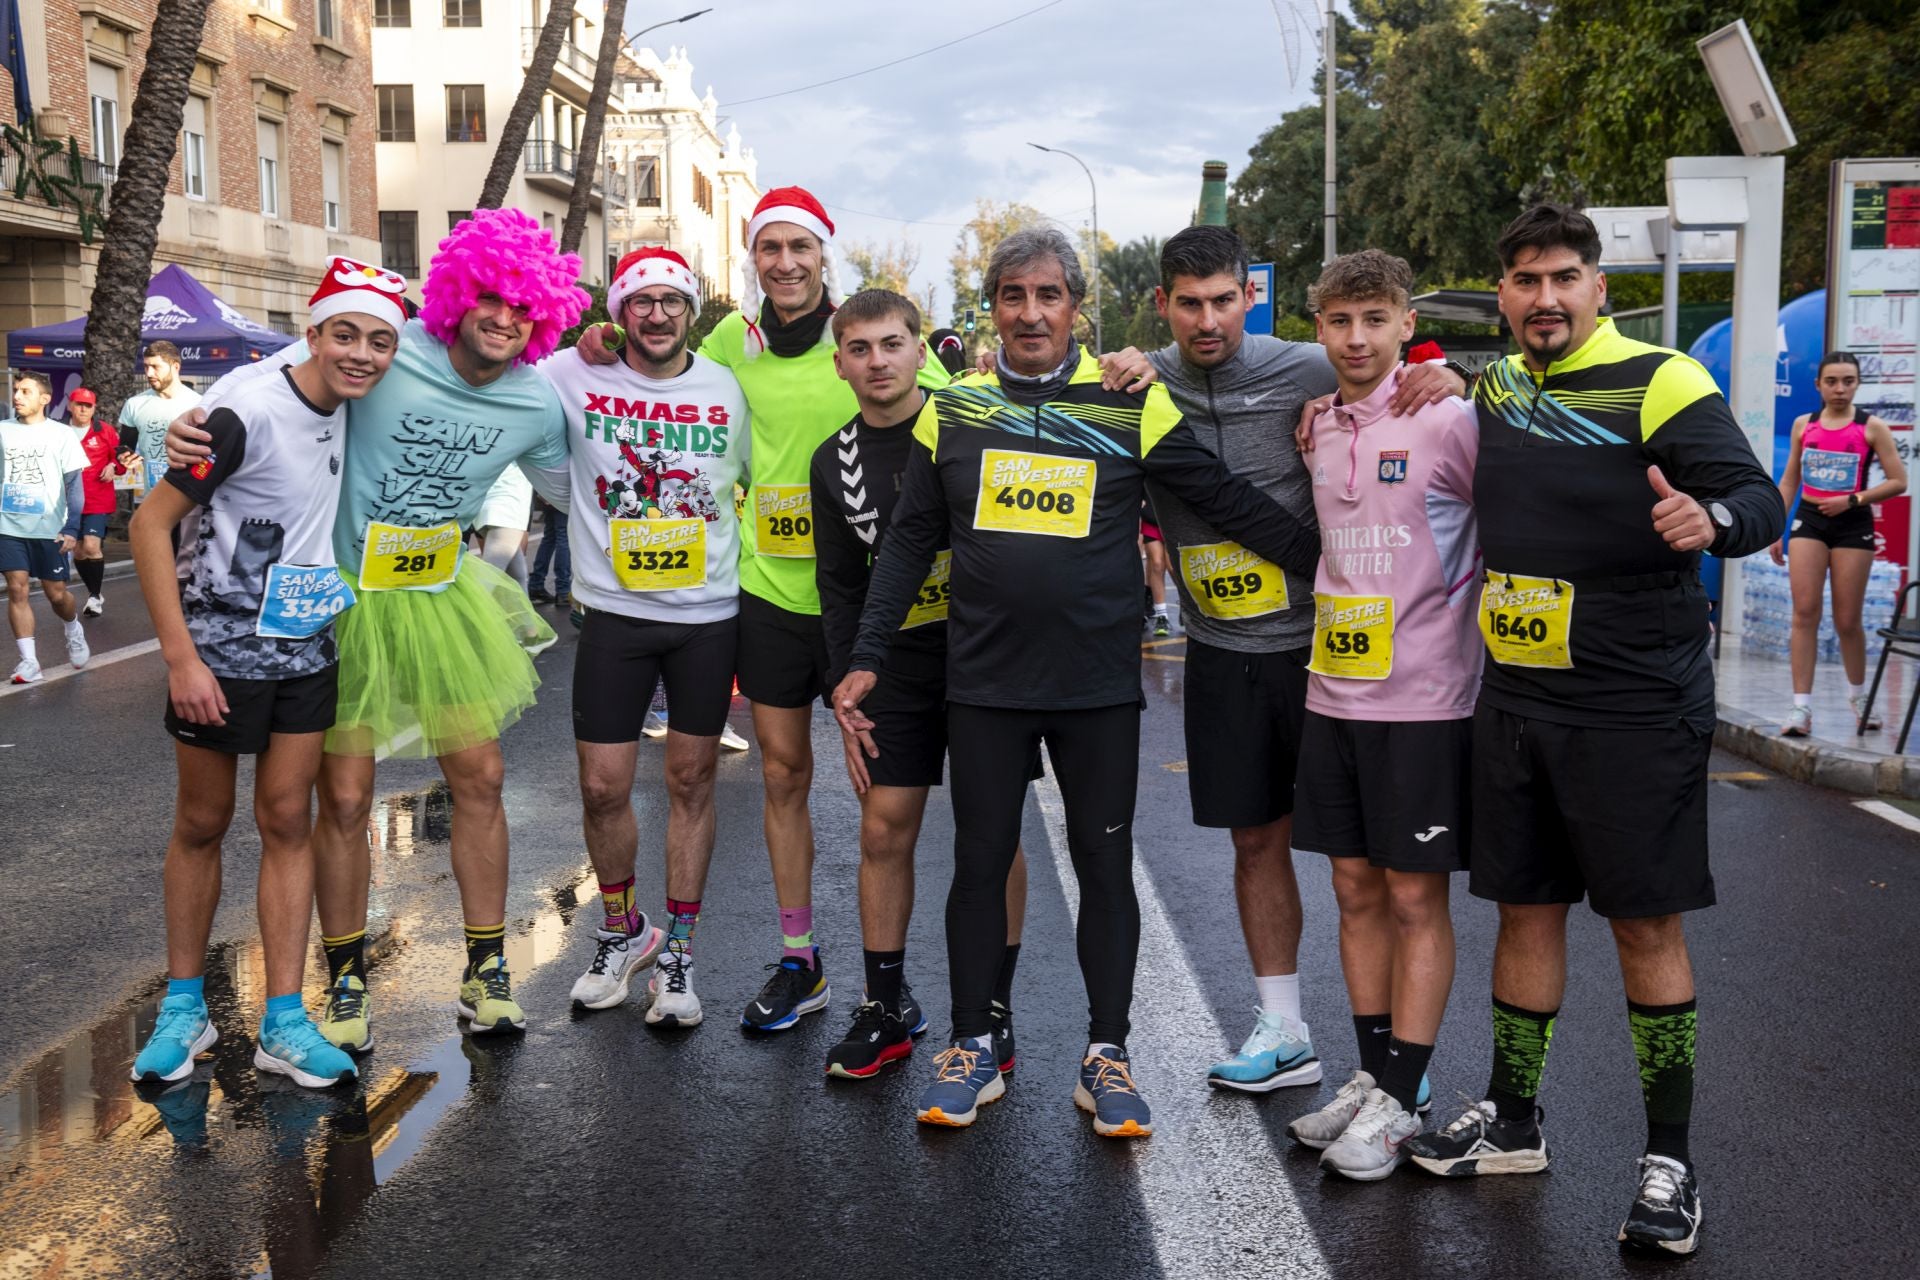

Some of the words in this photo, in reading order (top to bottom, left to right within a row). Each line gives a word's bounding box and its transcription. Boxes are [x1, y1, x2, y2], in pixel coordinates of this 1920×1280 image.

[180, 347, 201, 361] Club
[584, 391, 700, 424] XMAS
[707, 405, 730, 425] &
[390, 412, 505, 455] SAN
[584, 411, 729, 454] FRIENDS
[993, 458, 1032, 473] SAN
[1380, 461, 1405, 479] OL
[1810, 467, 1848, 482] 2079
[991, 465, 1088, 488] SILVESTRE
[758, 490, 779, 504] SAN
[995, 486, 1075, 515] 4008
[845, 507, 879, 524] hummel
[619, 525, 650, 540] SAN
[768, 516, 811, 537] 280
[375, 527, 456, 556] SILVESTRE
[378, 531, 413, 545] SAN
[618, 523, 699, 553] SILVESTRE
[393, 554, 436, 573] 281
[628, 550, 689, 571] 3322
[1188, 550, 1217, 569] SAN
[1343, 552, 1393, 576] BETTER
[280, 573, 316, 587] SAN
[1200, 573, 1262, 598] 1639
[1487, 581, 1507, 595] SAN
[280, 596, 345, 618] 3340
[1320, 601, 1335, 616] SAN
[1521, 602, 1560, 615] MURCIA
[1350, 617, 1385, 630] MURCIA
[1489, 611, 1547, 643] 1640
[1325, 631, 1370, 655] 438
